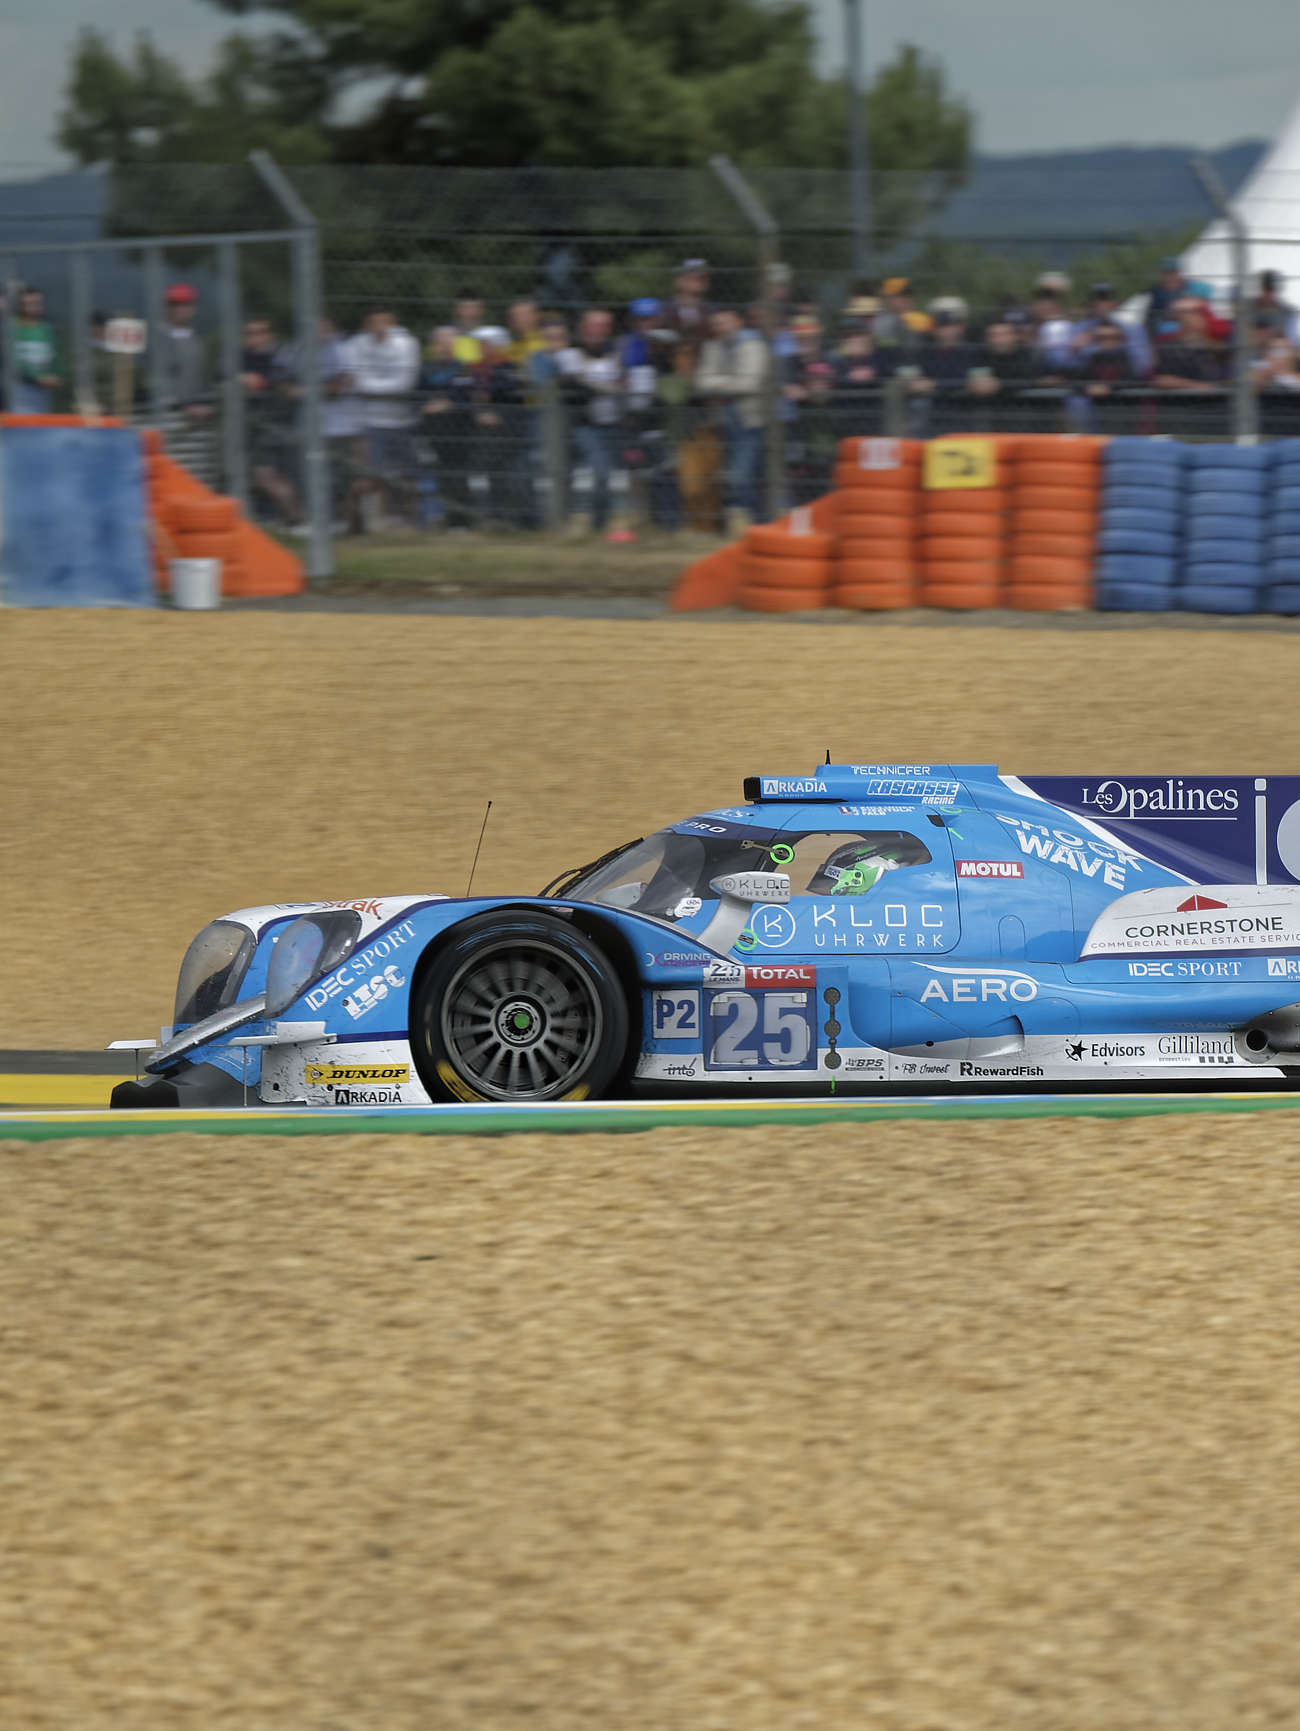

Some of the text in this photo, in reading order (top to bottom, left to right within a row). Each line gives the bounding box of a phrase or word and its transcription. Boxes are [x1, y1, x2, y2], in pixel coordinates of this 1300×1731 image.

[763, 779, 827, 795] ARKADIA
[867, 779, 960, 796] RASCASSE
[921, 796, 956, 805] RACING
[1082, 780, 1239, 818] Les Opalines
[996, 813, 1143, 872] SHOCK
[1016, 829, 1126, 891] WAVE
[959, 862, 1022, 877] MOTUL
[739, 879, 790, 888] KLOC
[813, 904, 943, 928] KLOC
[1125, 916, 1284, 939] CORNERSTONE
[814, 934, 944, 947] UHRWERK
[1091, 938, 1169, 949] COMMERCIAL
[1175, 937, 1206, 946] REAL
[1211, 935, 1255, 945] ESTATE
[304, 920, 417, 1011] IDEC SPORT
[748, 967, 811, 979] TOTAL
[1128, 962, 1242, 976] IDEC SPORT
[920, 978, 1039, 1003] AERO
[656, 999, 696, 1029] P2
[709, 991, 811, 1066] 25
[1091, 1043, 1146, 1057] Edvisors
[1158, 1035, 1235, 1055] Gilliland
[326, 1069, 407, 1079] DUNLOP
[974, 1065, 1044, 1077] RewardFish
[335, 1089, 402, 1104] ARKADIA
